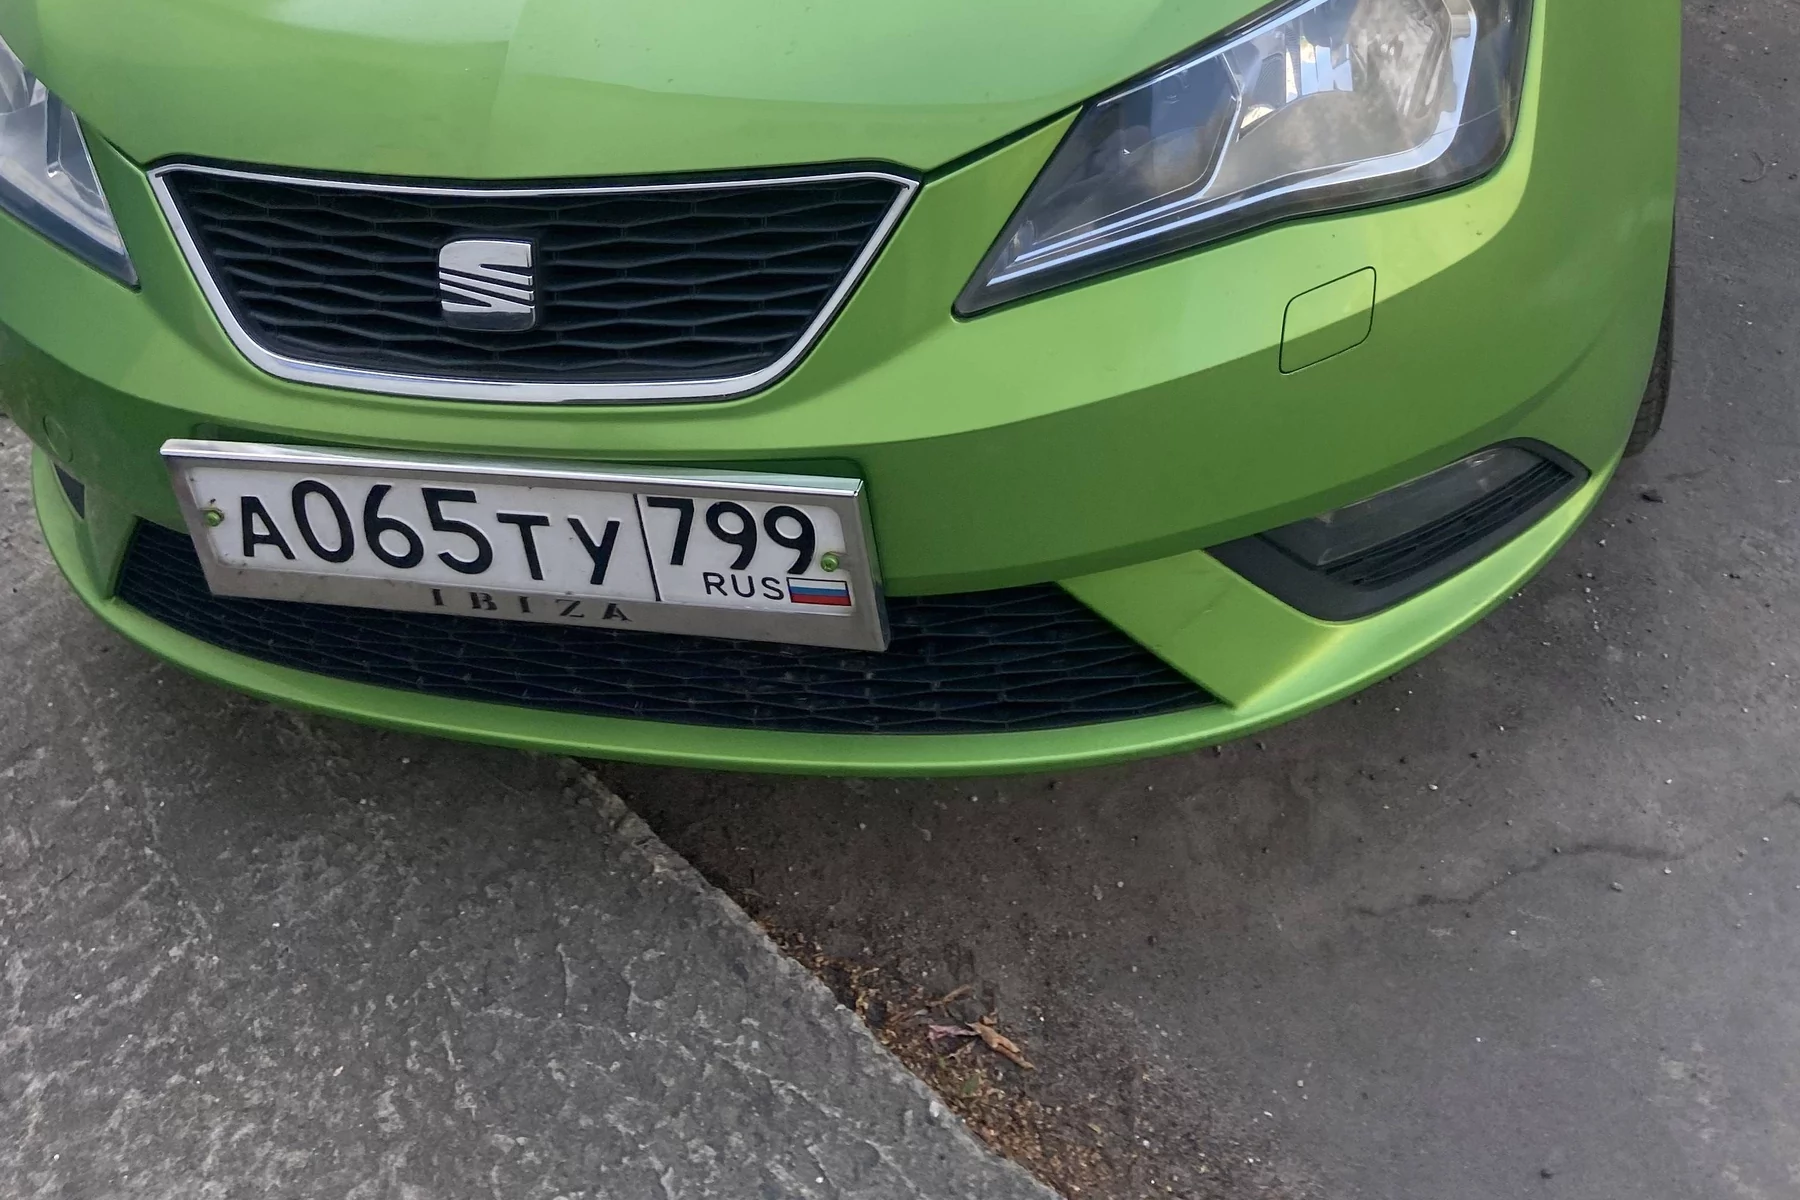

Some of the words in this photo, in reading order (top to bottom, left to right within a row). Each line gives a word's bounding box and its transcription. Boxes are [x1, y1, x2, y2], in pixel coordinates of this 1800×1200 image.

[646, 495, 816, 575] 799
[702, 571, 785, 601] RUS
[431, 588, 633, 622] IBIZA
